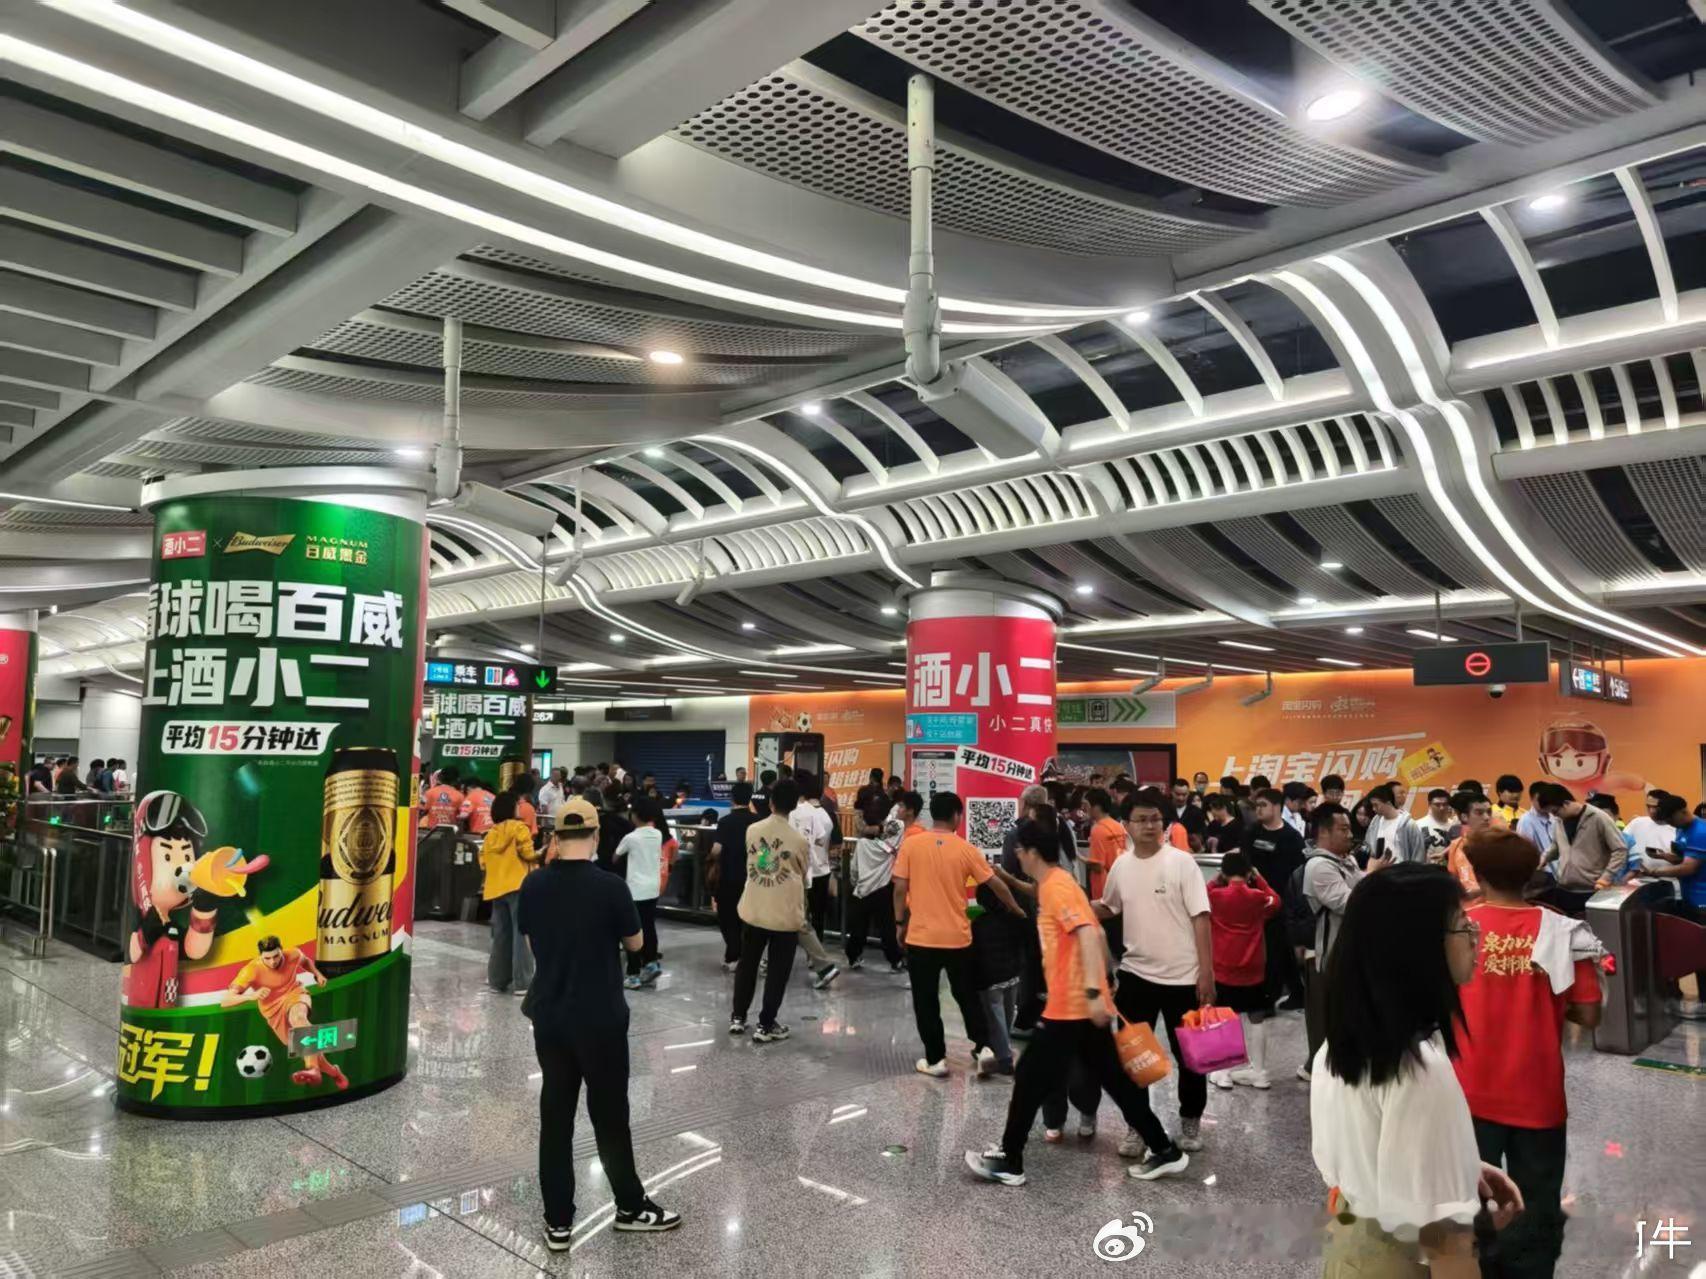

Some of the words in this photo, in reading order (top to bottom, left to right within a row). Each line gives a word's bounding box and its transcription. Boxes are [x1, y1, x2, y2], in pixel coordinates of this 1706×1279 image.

[164, 536, 201, 556] 酒小二
[230, 535, 288, 548] Budweiser
[306, 535, 368, 548] MAGNUM
[142, 647, 370, 710] 上酒小二
[913, 651, 1053, 708] 酒小二
[166, 724, 321, 752] 平均15分钟达
[432, 717, 516, 740] 上酒小二
[444, 745, 500, 756] 平均15分钟达
[961, 748, 1033, 780] 平均15分钟达
[1208, 746, 1405, 788] 上淘宝闪购
[323, 928, 389, 945] MAGNUM
